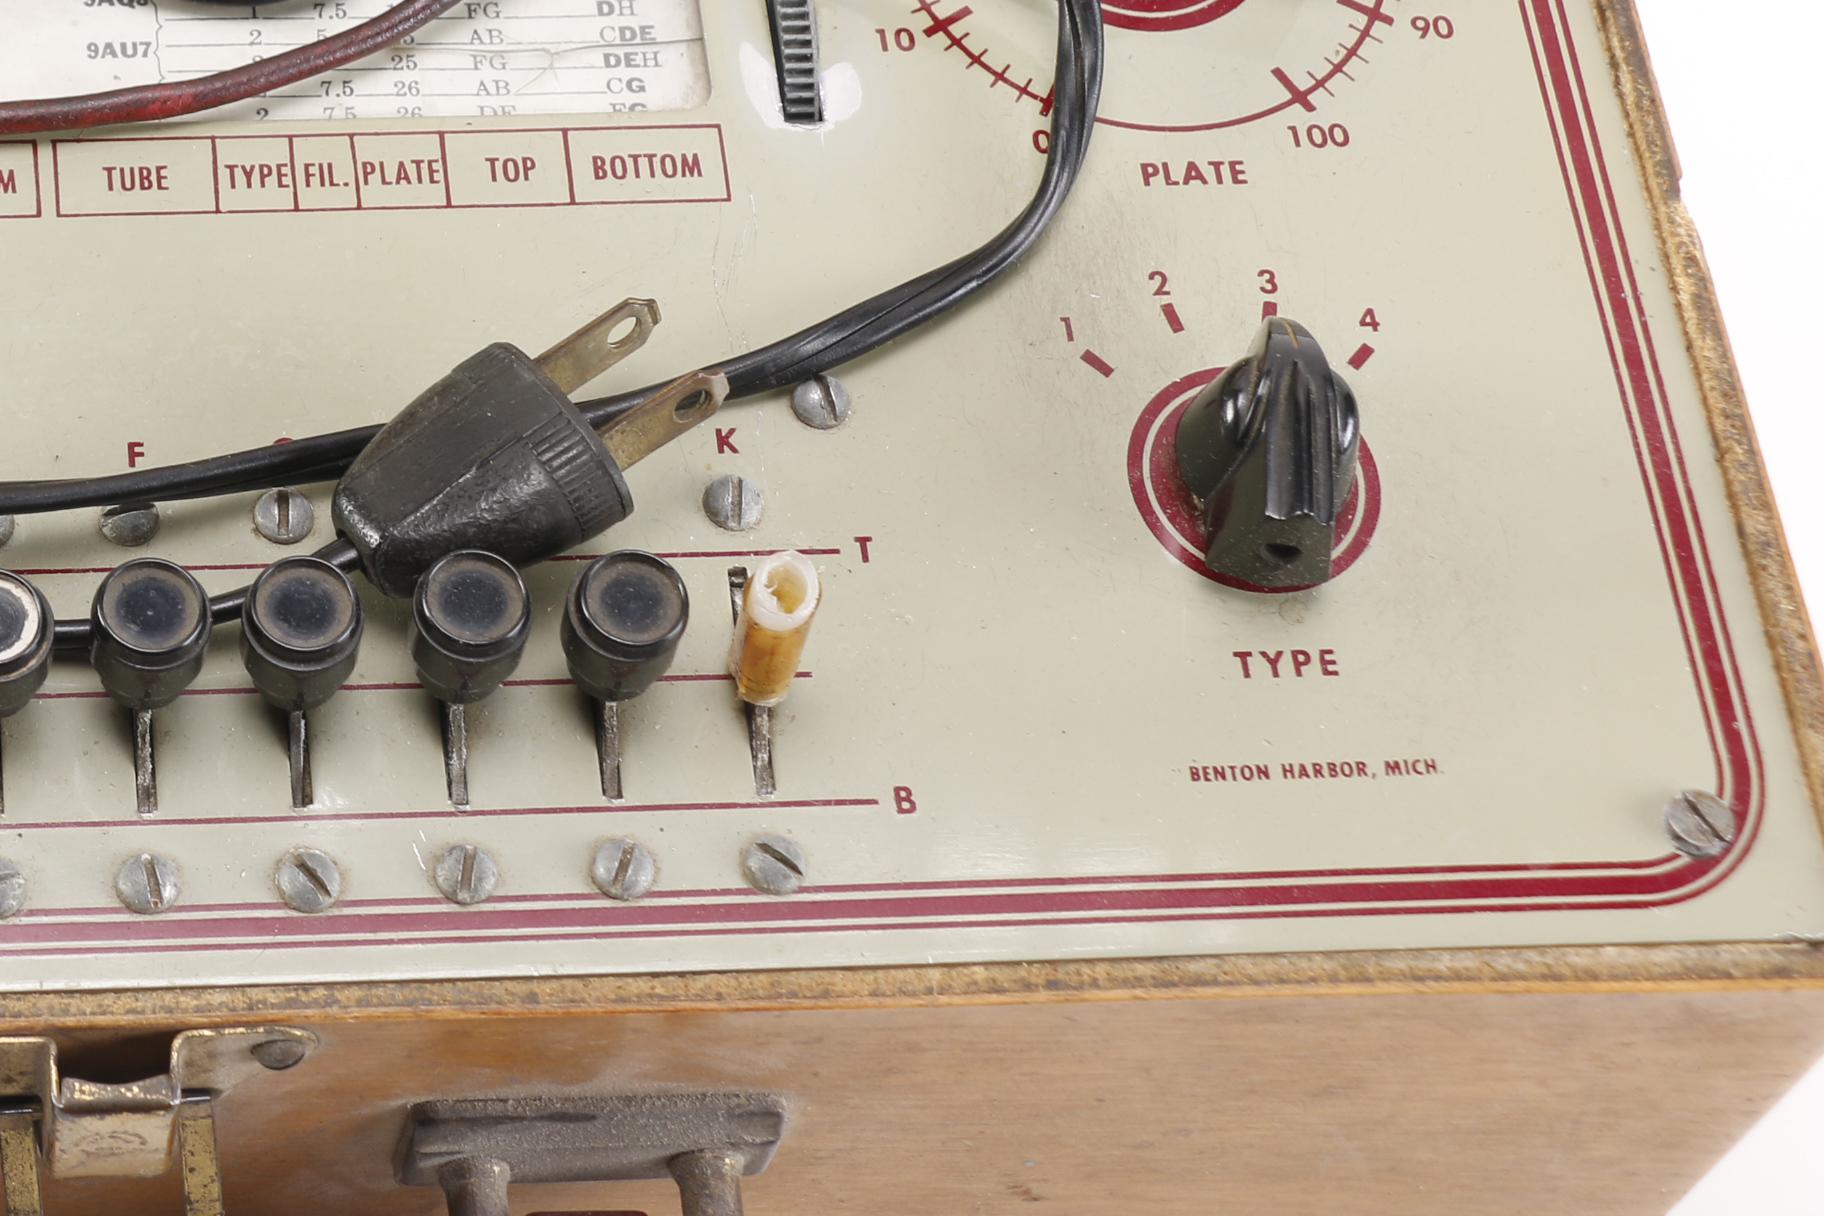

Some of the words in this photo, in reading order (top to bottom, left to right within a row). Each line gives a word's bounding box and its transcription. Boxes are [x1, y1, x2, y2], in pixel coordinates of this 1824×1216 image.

[313, 3, 347, 19] 7.5
[464, 2, 502, 19] FG
[596, 0, 637, 17] DH
[249, 29, 262, 46] 2
[469, 29, 504, 45] AB
[600, 25, 657, 43] CDE
[874, 27, 916, 52] 10
[1410, 16, 1454, 41] 90
[87, 41, 151, 59] 9AU7
[391, 55, 418, 71] 25
[472, 54, 508, 71] FG
[603, 51, 662, 69] DEH
[320, 80, 354, 97] 7.5
[394, 80, 421, 97] 26
[476, 81, 512, 96] AB
[607, 77, 647, 94] CG
[1032, 129, 1051, 154] 0
[1287, 124, 1350, 150] 100
[102, 165, 169, 192] TUBE
[224, 163, 289, 189] TYPE
[304, 161, 350, 187] FIL.
[361, 159, 441, 186] PLATE
[484, 156, 537, 183] TOP
[592, 152, 703, 179] BOTTOM
[1140, 160, 1248, 188] PLATE
[1148, 271, 1171, 296] 2
[1257, 269, 1278, 294] 3
[1059, 317, 1074, 342] 1
[1358, 307, 1380, 332] 4
[714, 427, 739, 453] K
[128, 441, 145, 467] F
[854, 536, 872, 562] T
[1233, 649, 1340, 678] TYPE
[1189, 763, 1271, 782] BENTON
[1281, 760, 1377, 782] HARBOR,
[893, 786, 917, 814] B
